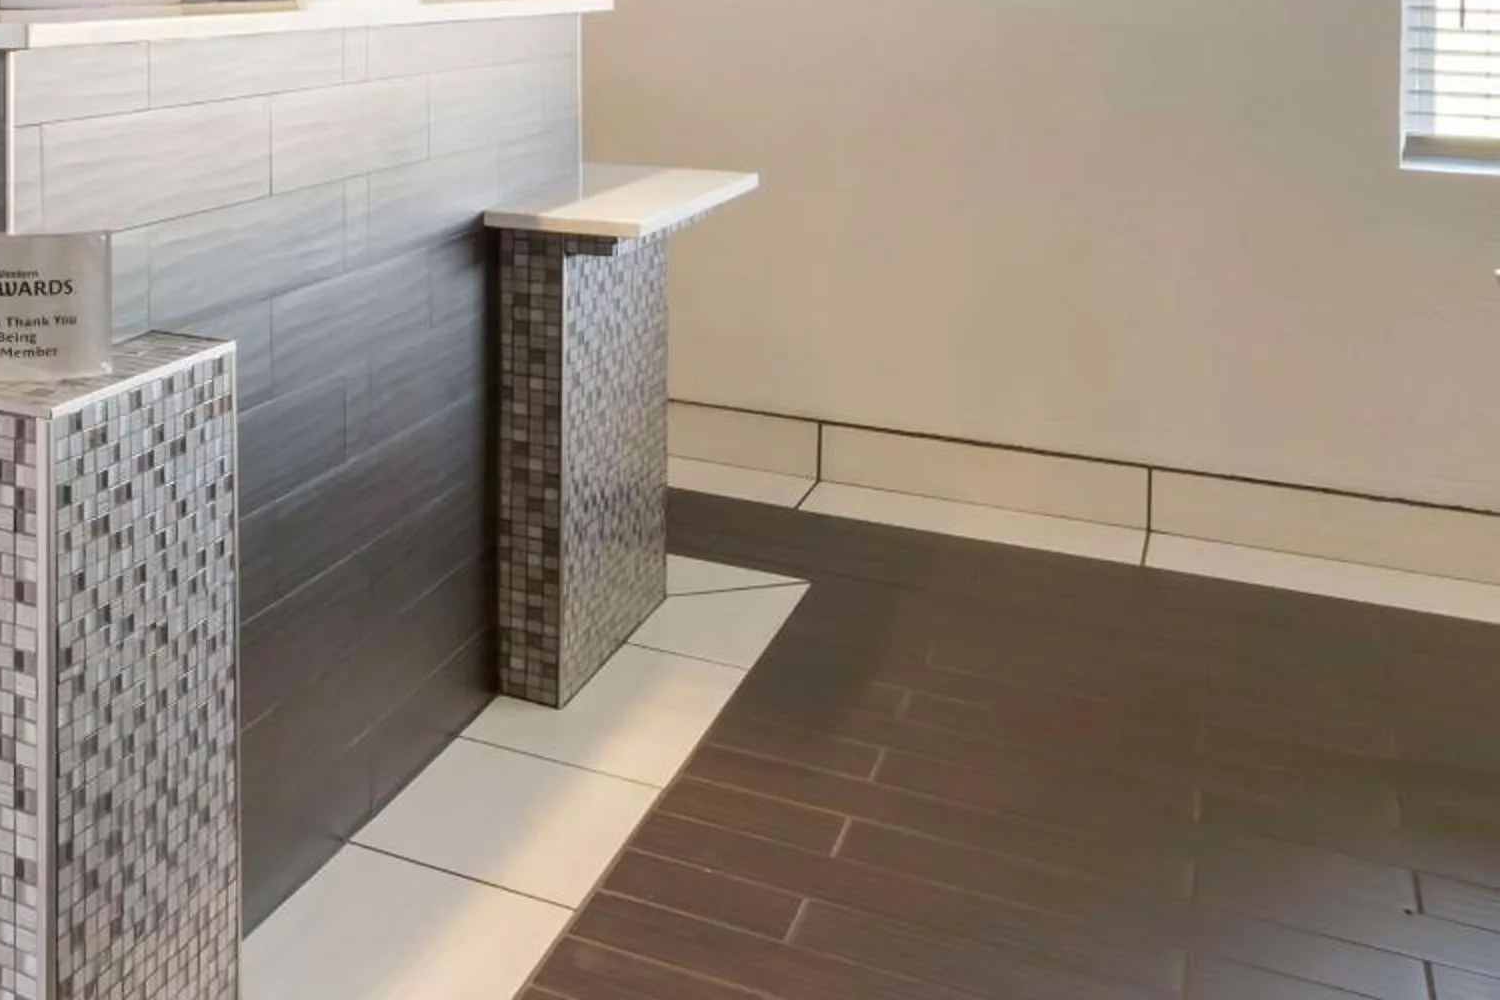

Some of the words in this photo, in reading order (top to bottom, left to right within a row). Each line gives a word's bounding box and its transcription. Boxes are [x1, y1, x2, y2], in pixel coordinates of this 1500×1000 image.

[6, 316, 49, 328] Thank
[53, 314, 77, 326] You
[0, 346, 58, 359] Member
